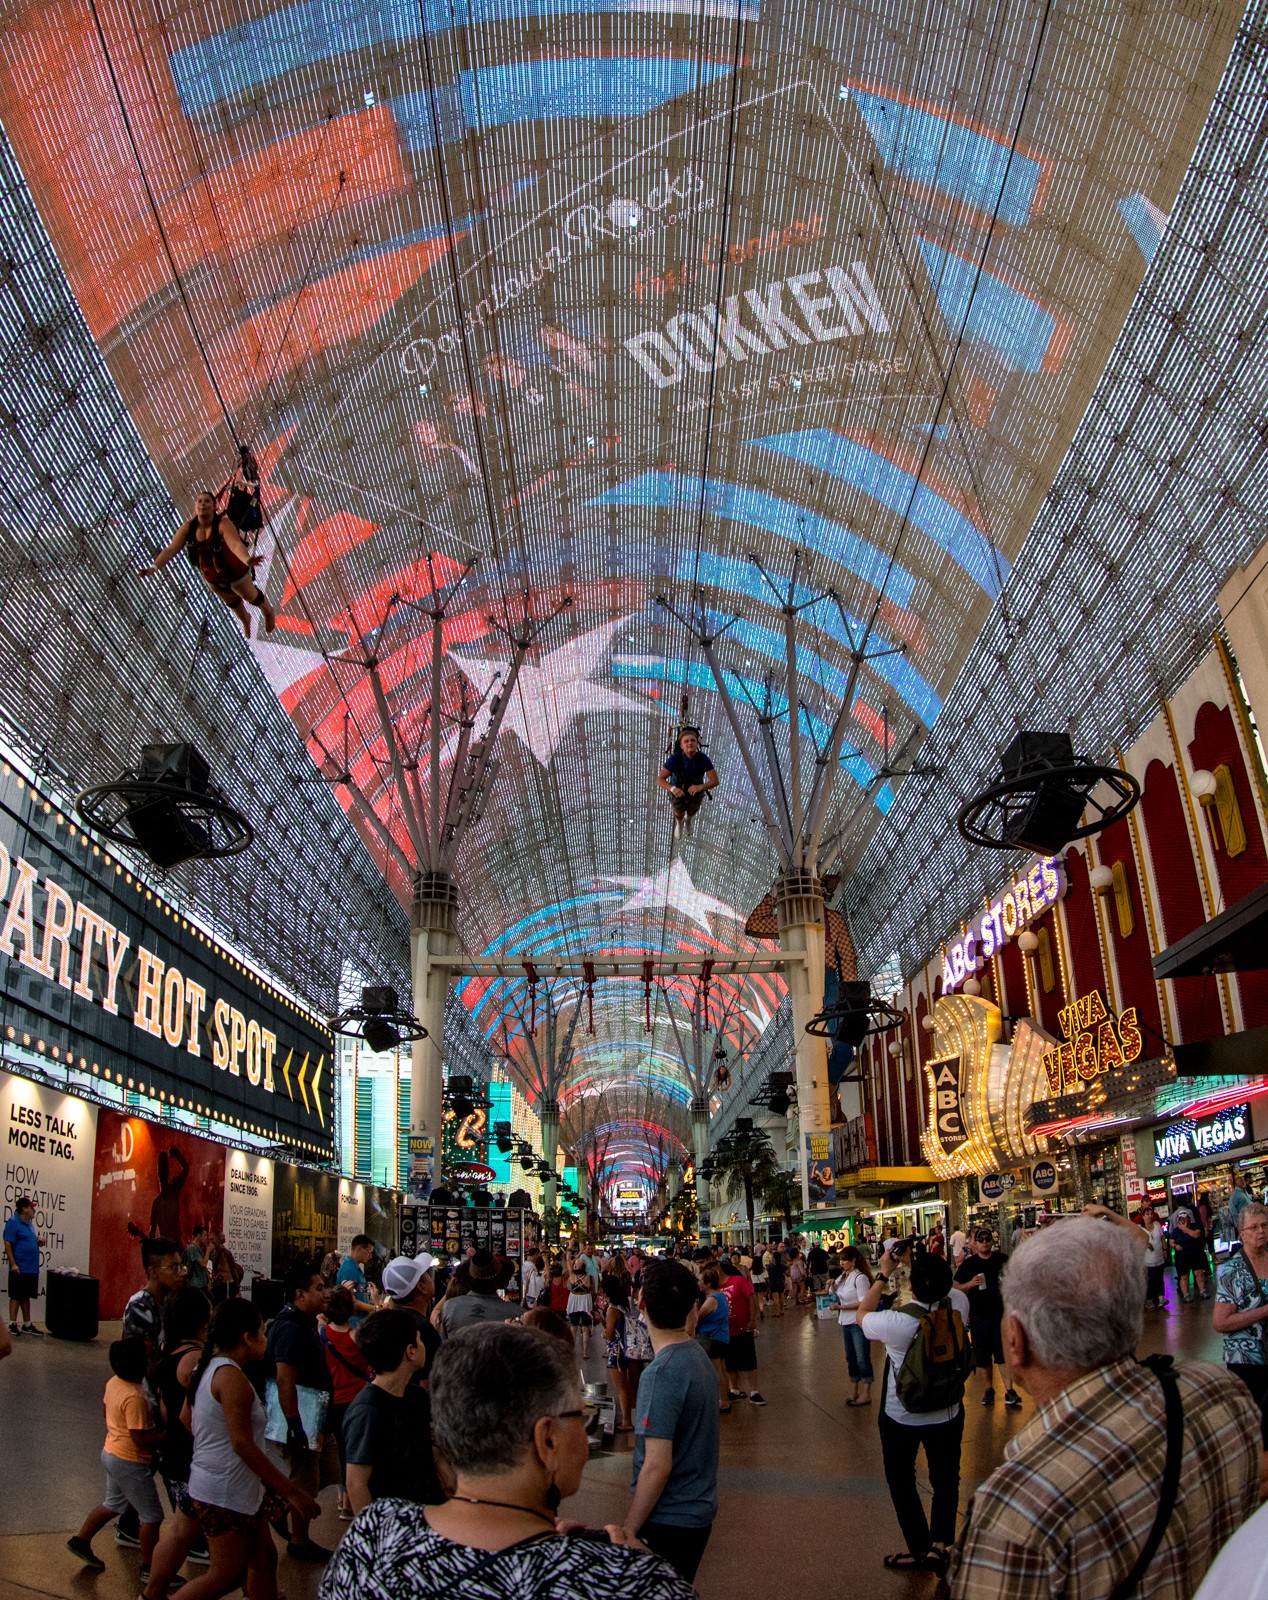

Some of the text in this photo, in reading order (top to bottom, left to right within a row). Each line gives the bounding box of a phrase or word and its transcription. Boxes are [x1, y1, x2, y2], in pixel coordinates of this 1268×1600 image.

[401, 166, 704, 375] Downtown Rocks
[623, 261, 892, 389] DOKKEN
[941, 855, 1060, 996] ABC STORES
[134, 945, 206, 1057] HOT
[213, 998, 277, 1093] SPOT
[1057, 989, 1107, 1038] VIVA
[1042, 1007, 1143, 1095] VEGAS
[10, 1103, 78, 1140] LESS TALK.
[8, 1127, 75, 1161] MORE TAG.
[410, 1139, 433, 1149] NOW
[939, 1134, 967, 1143] STORES
[1155, 1134, 1190, 1159] VIVA
[1191, 1116, 1246, 1151] VEGAS
[5, 1162, 39, 1186] HOW
[231, 1168, 268, 1186] DEALING PAIRS.
[1000, 1173, 1014, 1184] ABC
[1035, 1168, 1054, 1179] ABC
[230, 1182, 246, 1194] SINCE
[229, 1204, 267, 1217] YOUR GRANDMA
[35, 1211, 54, 1229] OU
[229, 1216, 269, 1230] USED TO GAMBLE
[243, 1229, 256, 1240] HOW
[256, 1230, 267, 1241] ELSE
[228, 1240, 262, 1251] DO YOU THINK
